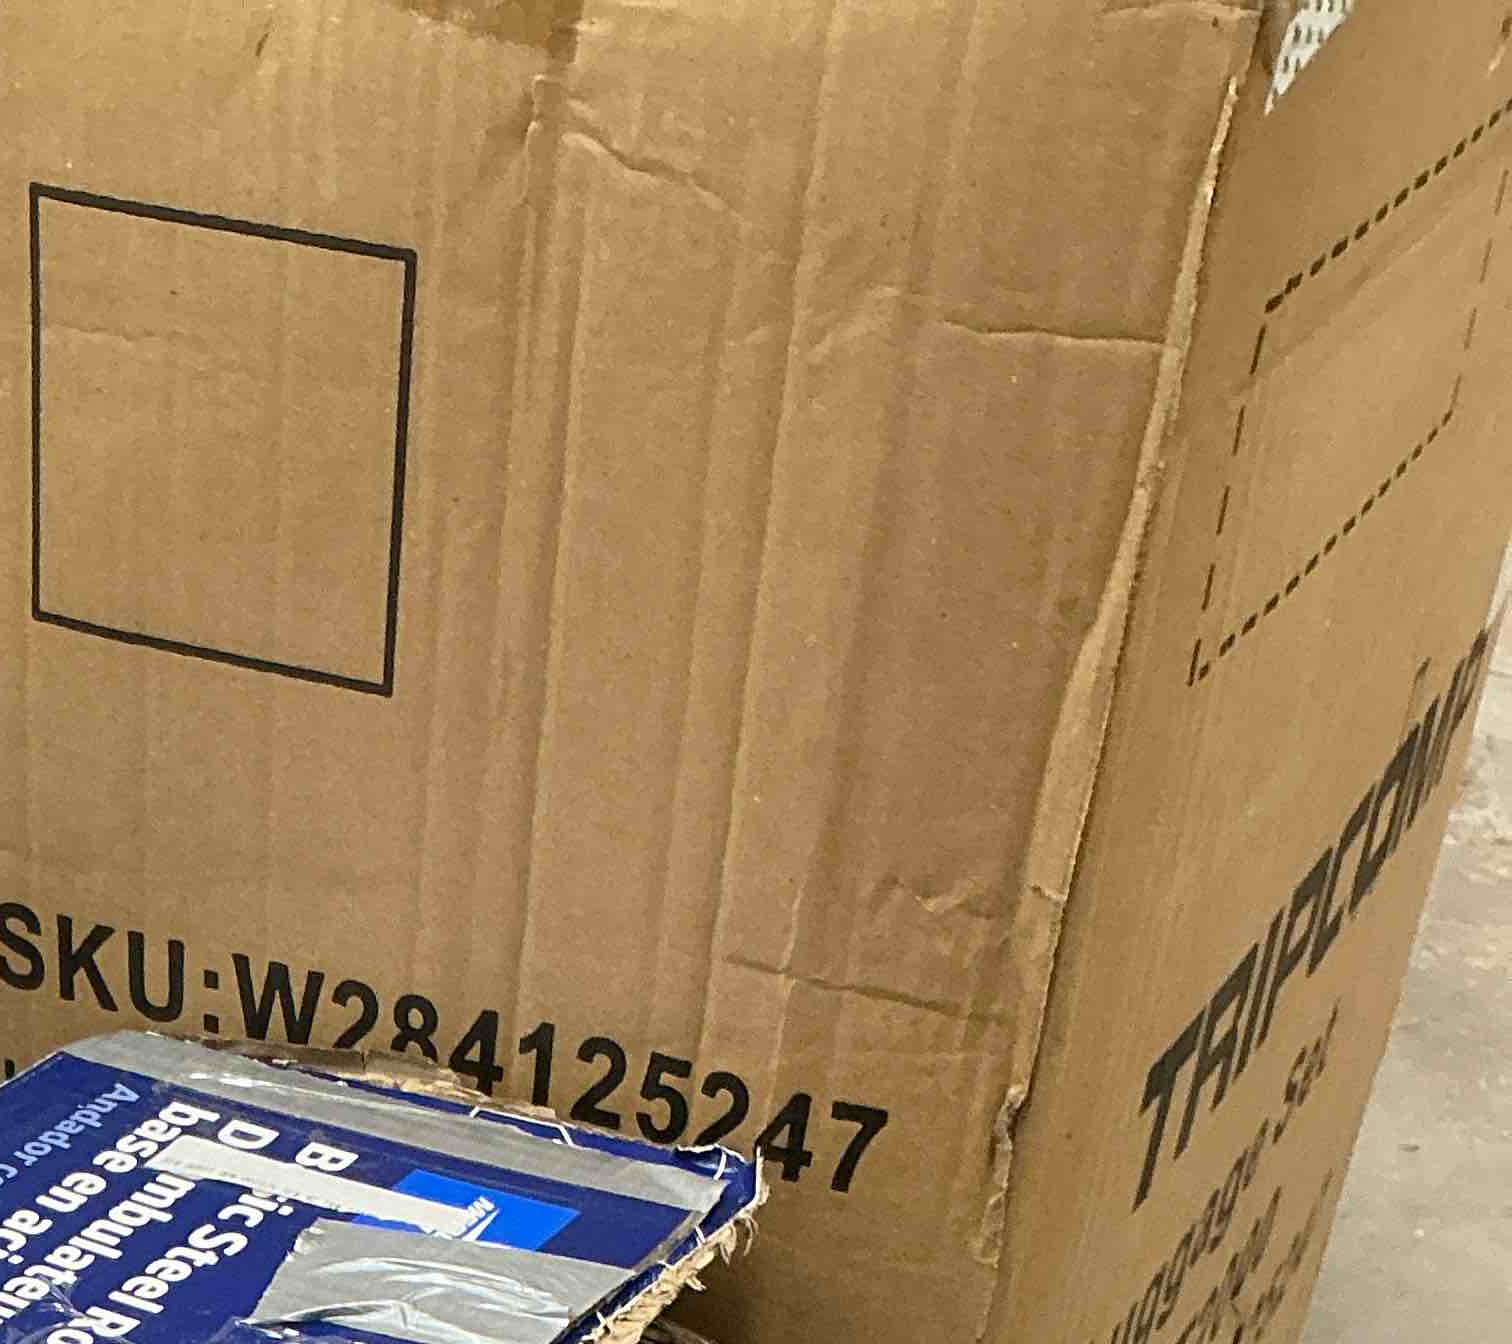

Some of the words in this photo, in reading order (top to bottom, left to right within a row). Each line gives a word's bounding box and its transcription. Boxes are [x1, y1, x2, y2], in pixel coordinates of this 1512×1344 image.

[23, 1083, 141, 1167] Andador
[92, 1100, 220, 1173] base
[36, 1171, 107, 1212] en
[217, 1141, 359, 1228] Bic
[108, 1222, 248, 1314] Steel
